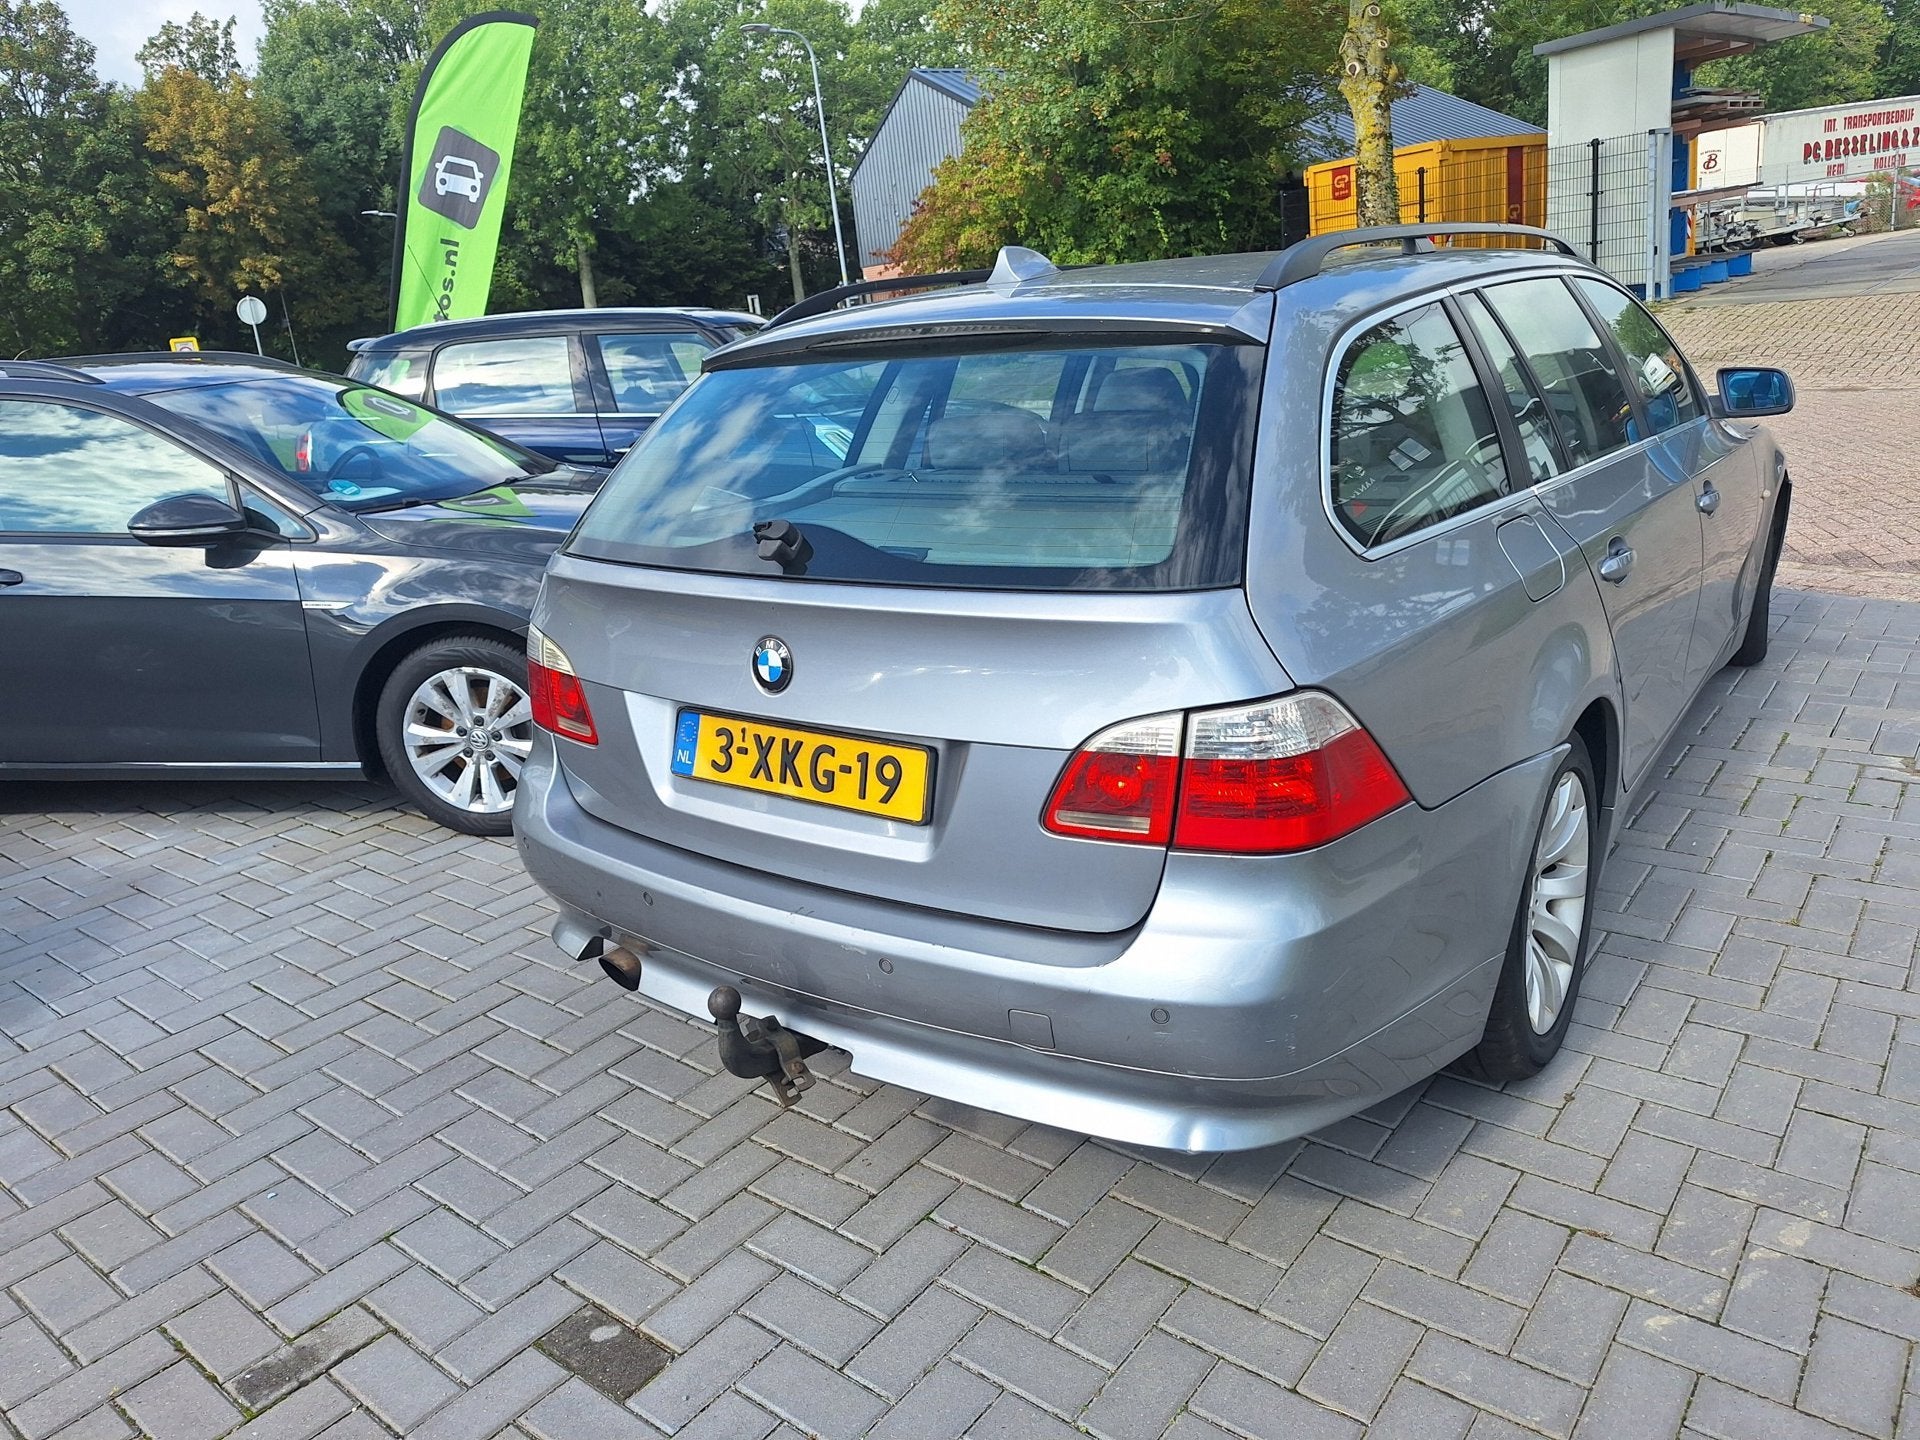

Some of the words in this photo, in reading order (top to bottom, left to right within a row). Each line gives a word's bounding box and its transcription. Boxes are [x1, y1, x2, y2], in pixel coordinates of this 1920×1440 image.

[1824, 118, 1838, 133] INT.
[1843, 108, 1915, 130] TRANSPORTBEDRIJF
[676, 749, 693, 765] NL
[710, 727, 903, 804] 3-XKG-19
